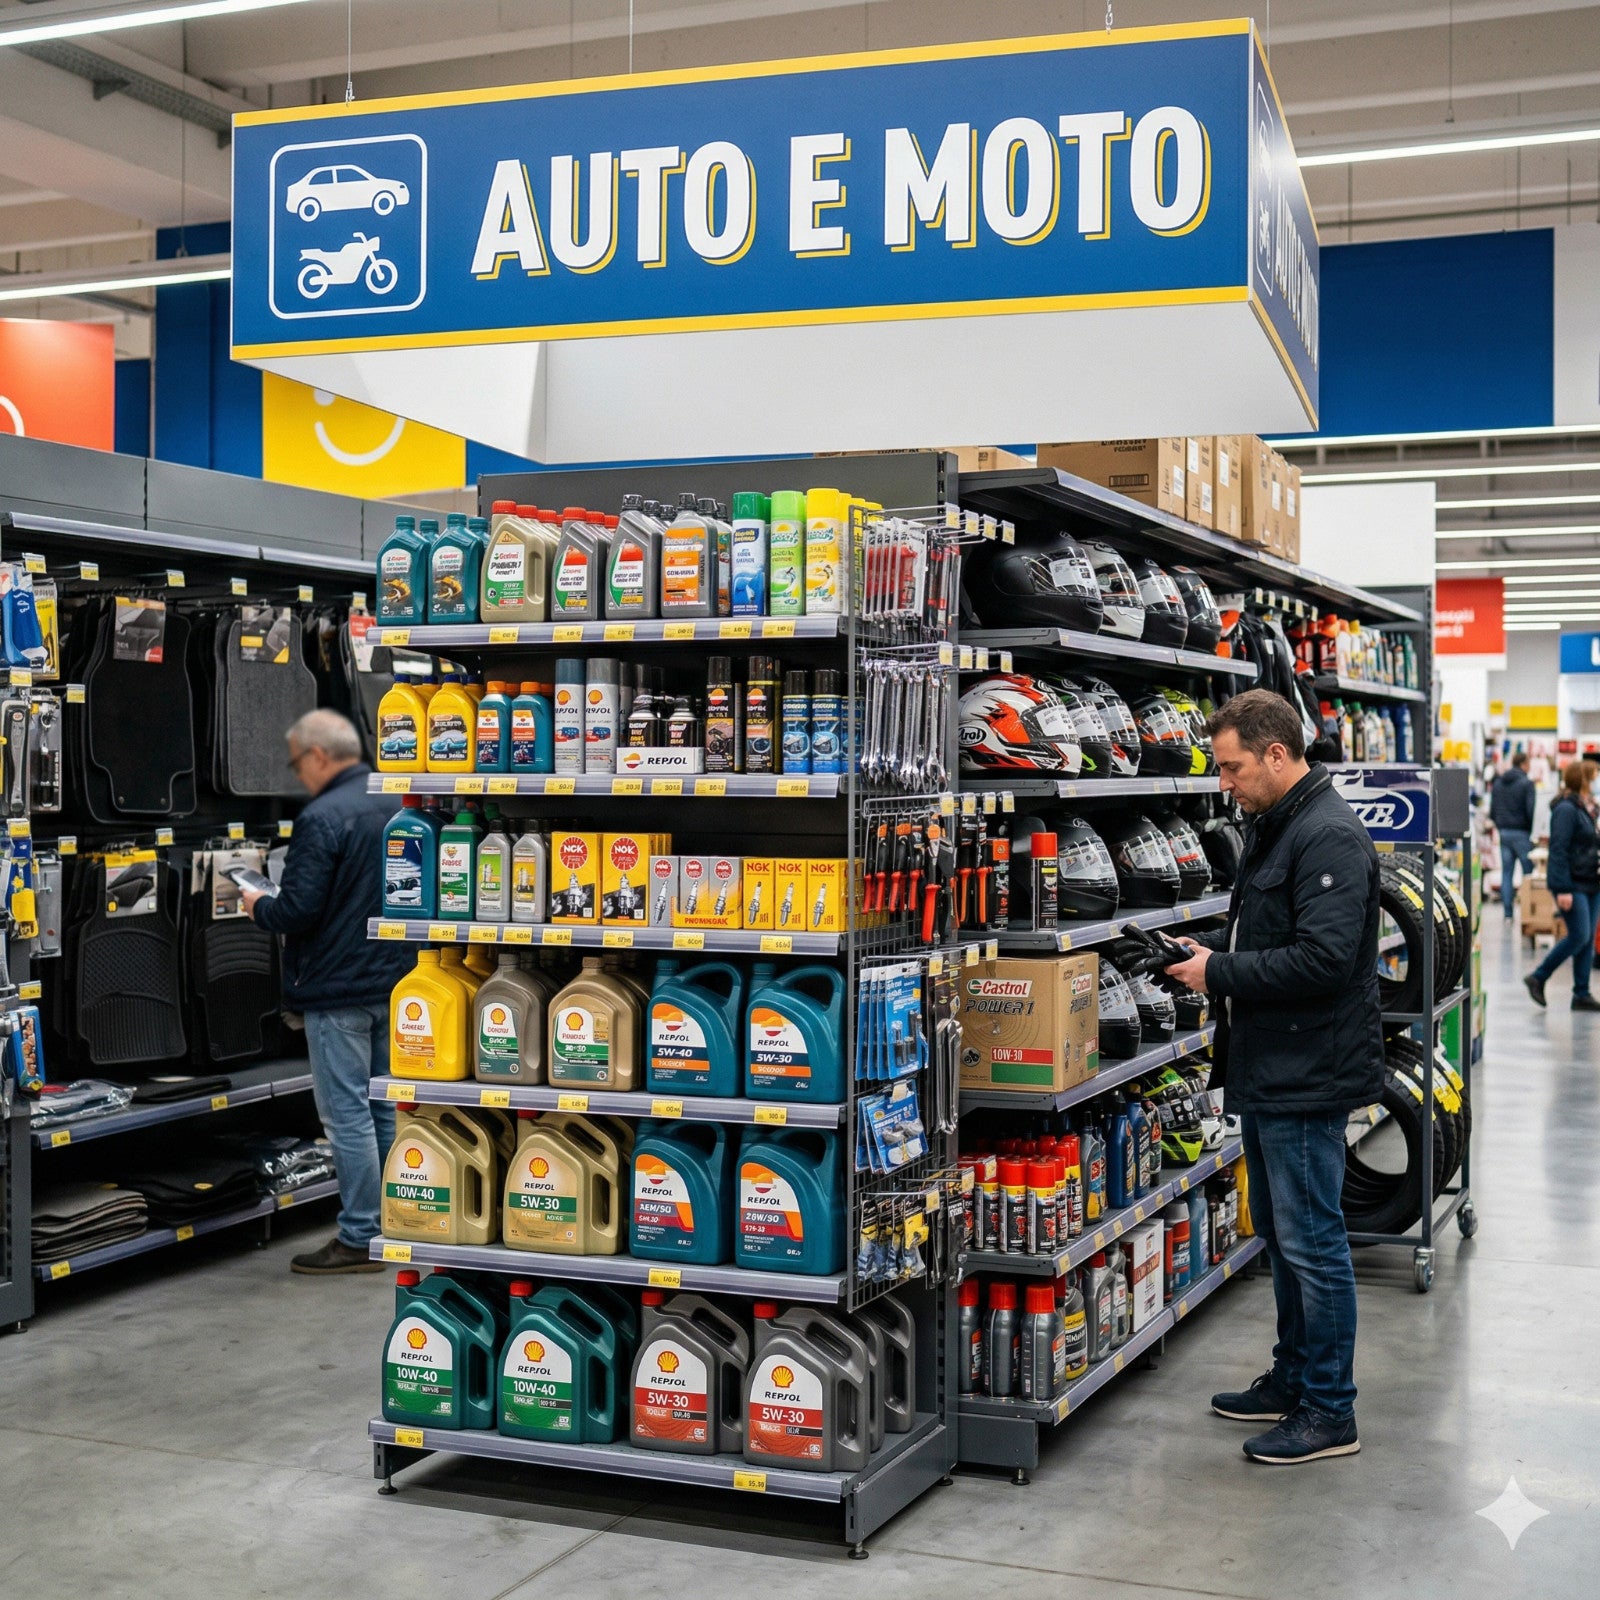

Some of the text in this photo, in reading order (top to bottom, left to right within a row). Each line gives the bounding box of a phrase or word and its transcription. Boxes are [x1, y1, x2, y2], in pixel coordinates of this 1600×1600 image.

[470, 105, 1211, 280] AUTO E MOTO
[647, 757, 688, 765] REPSOL
[746, 863, 770, 872] NGK
[779, 863, 802, 872] NGK
[811, 864, 834, 873] NGK
[981, 981, 1027, 995] Castrol
[659, 1034, 690, 1042] REPSOL
[758, 1039, 789, 1047] REPSOL
[657, 1048, 693, 1057] 5W-40
[992, 1048, 1023, 1061] 10W-30
[756, 1054, 792, 1064] 5W-30
[400, 1172, 428, 1181] REPSOL
[524, 1182, 555, 1191] REPSOL
[395, 1185, 435, 1200] 10W-40
[641, 1187, 673, 1197] REPSOL
[520, 1195, 559, 1210] 5W-30
[747, 1197, 781, 1206] REPSOL
[401, 1352, 433, 1362] REPSOL
[397, 1367, 438, 1383] 10W-40
[518, 1365, 552, 1375] REPSOL
[651, 1376, 686, 1386] REPSOL
[513, 1380, 556, 1396] 10W-40
[647, 1392, 689, 1408] 5W-30
[765, 1391, 801, 1402] REPSOL
[762, 1408, 805, 1423] 5W-30
